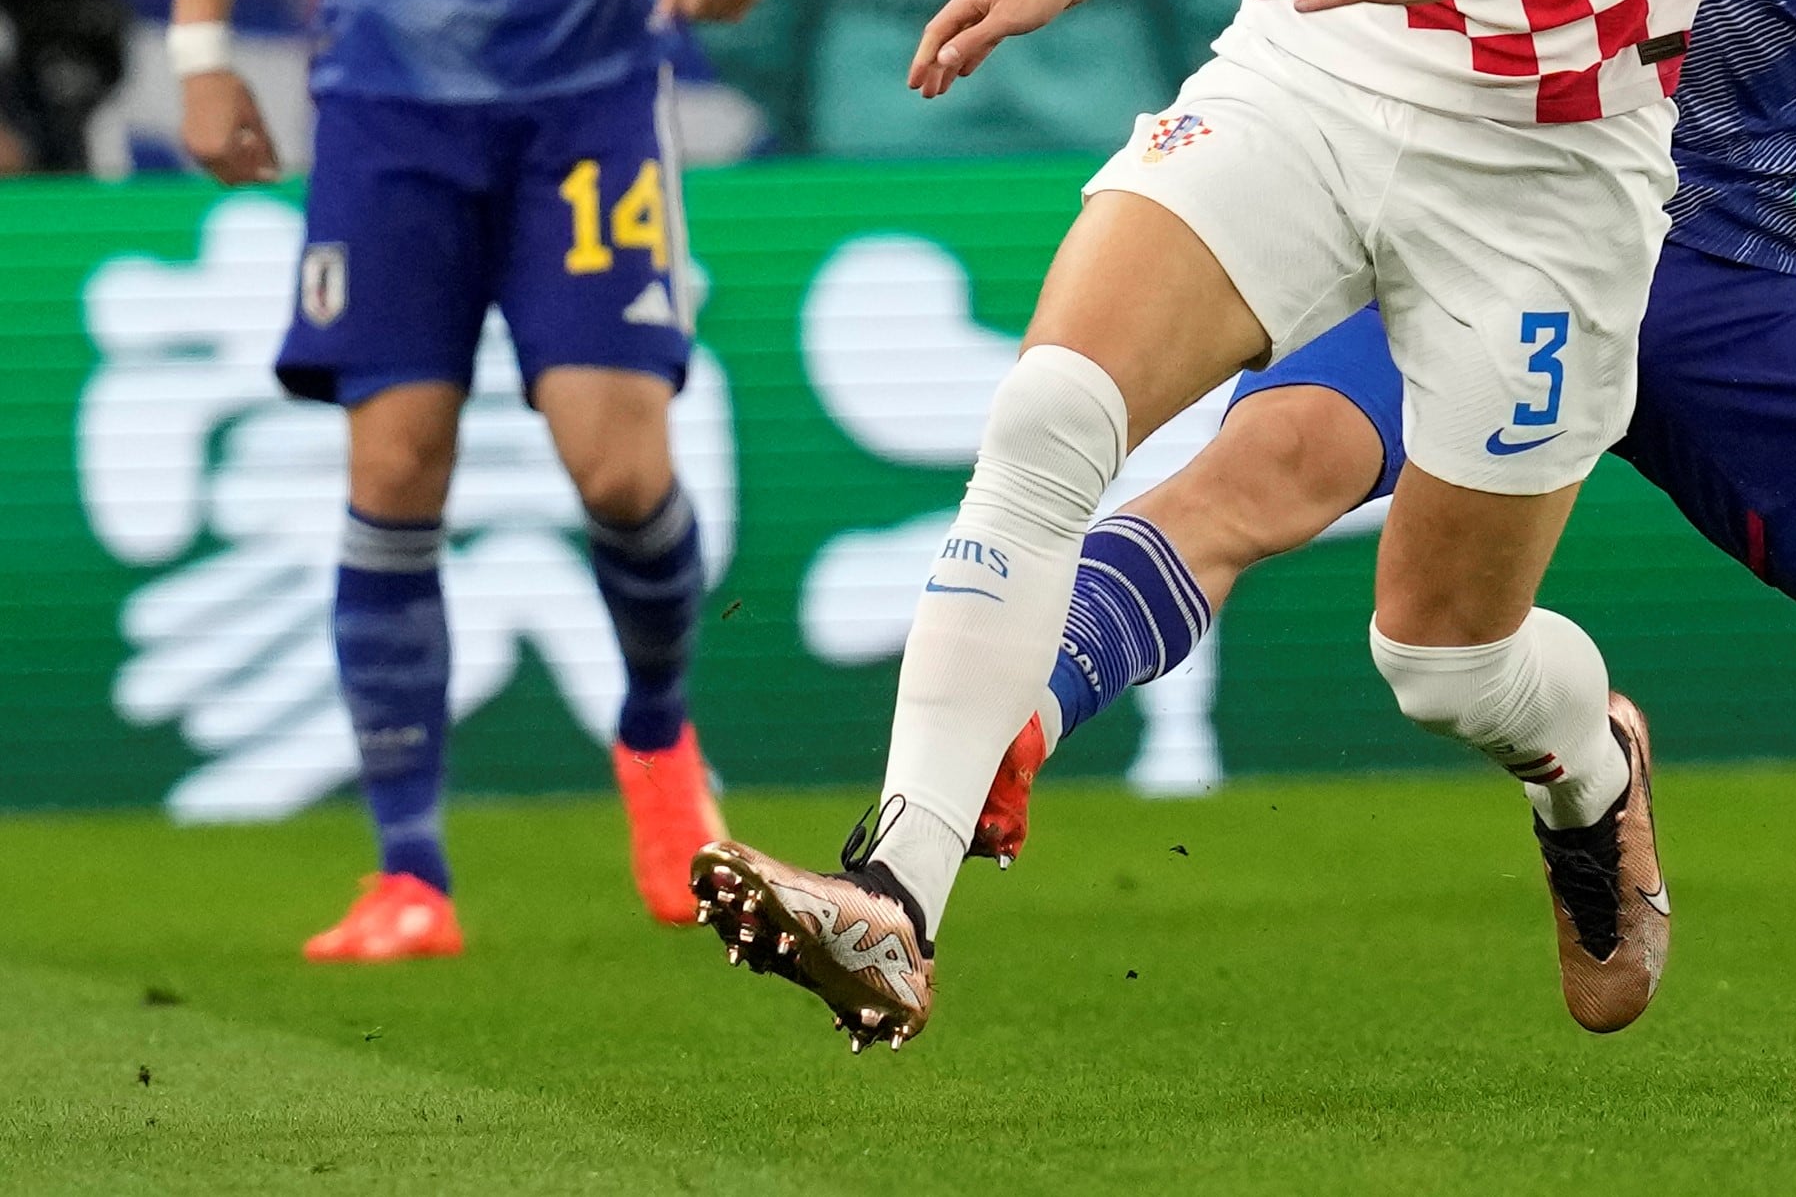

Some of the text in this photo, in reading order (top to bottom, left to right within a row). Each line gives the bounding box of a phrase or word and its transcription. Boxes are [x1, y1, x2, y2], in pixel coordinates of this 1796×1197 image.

[560, 158, 669, 275] 14
[1512, 311, 1569, 426] 3
[940, 538, 1010, 580] HNS
